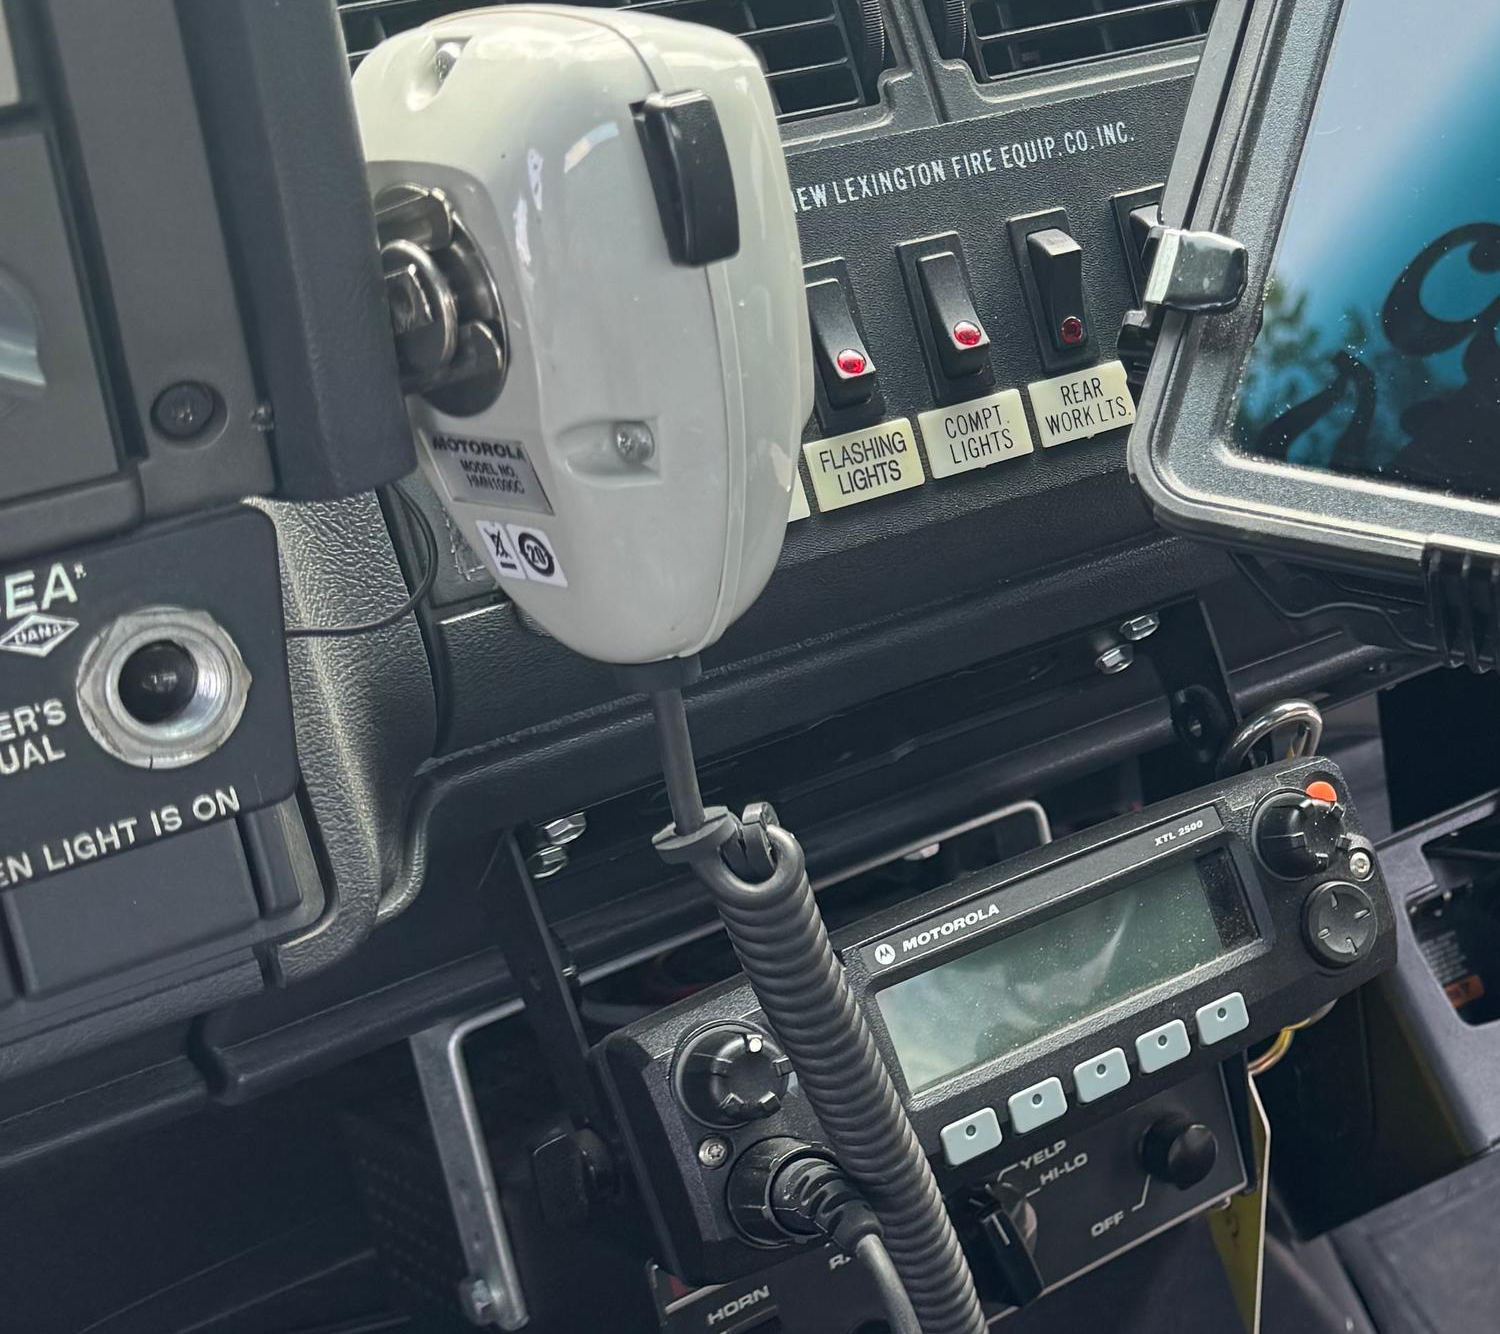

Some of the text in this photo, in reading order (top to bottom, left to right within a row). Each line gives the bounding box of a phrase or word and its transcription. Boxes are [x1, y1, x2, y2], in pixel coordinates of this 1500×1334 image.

[832, 158, 948, 204] LEXINGTON
[950, 148, 997, 179] FIRE
[1098, 121, 1136, 146] INC.
[1060, 377, 1105, 406] REAR
[944, 405, 1012, 440] COMPT.
[1045, 396, 1134, 437] WORK LTS.
[433, 435, 527, 462] MOTOROLA
[819, 431, 907, 473] FLASHING
[949, 429, 1015, 465] LIGHTS
[459, 459, 520, 480] MODEL NO.
[838, 459, 903, 496] LIGHTS
[526, 541, 547, 566] 20
[0, 561, 80, 620] EA
[42, 817, 138, 872] LIGHT
[150, 804, 183, 836] IS
[192, 786, 241, 821] ON
[1154, 819, 1204, 846] XTL 2500
[902, 903, 1000, 953] MOTOROLA
[1020, 1139, 1067, 1170] YELP
[1039, 1152, 1088, 1186] HI-LO
[1091, 1210, 1124, 1237] OFF
[707, 1285, 770, 1325] HORN
